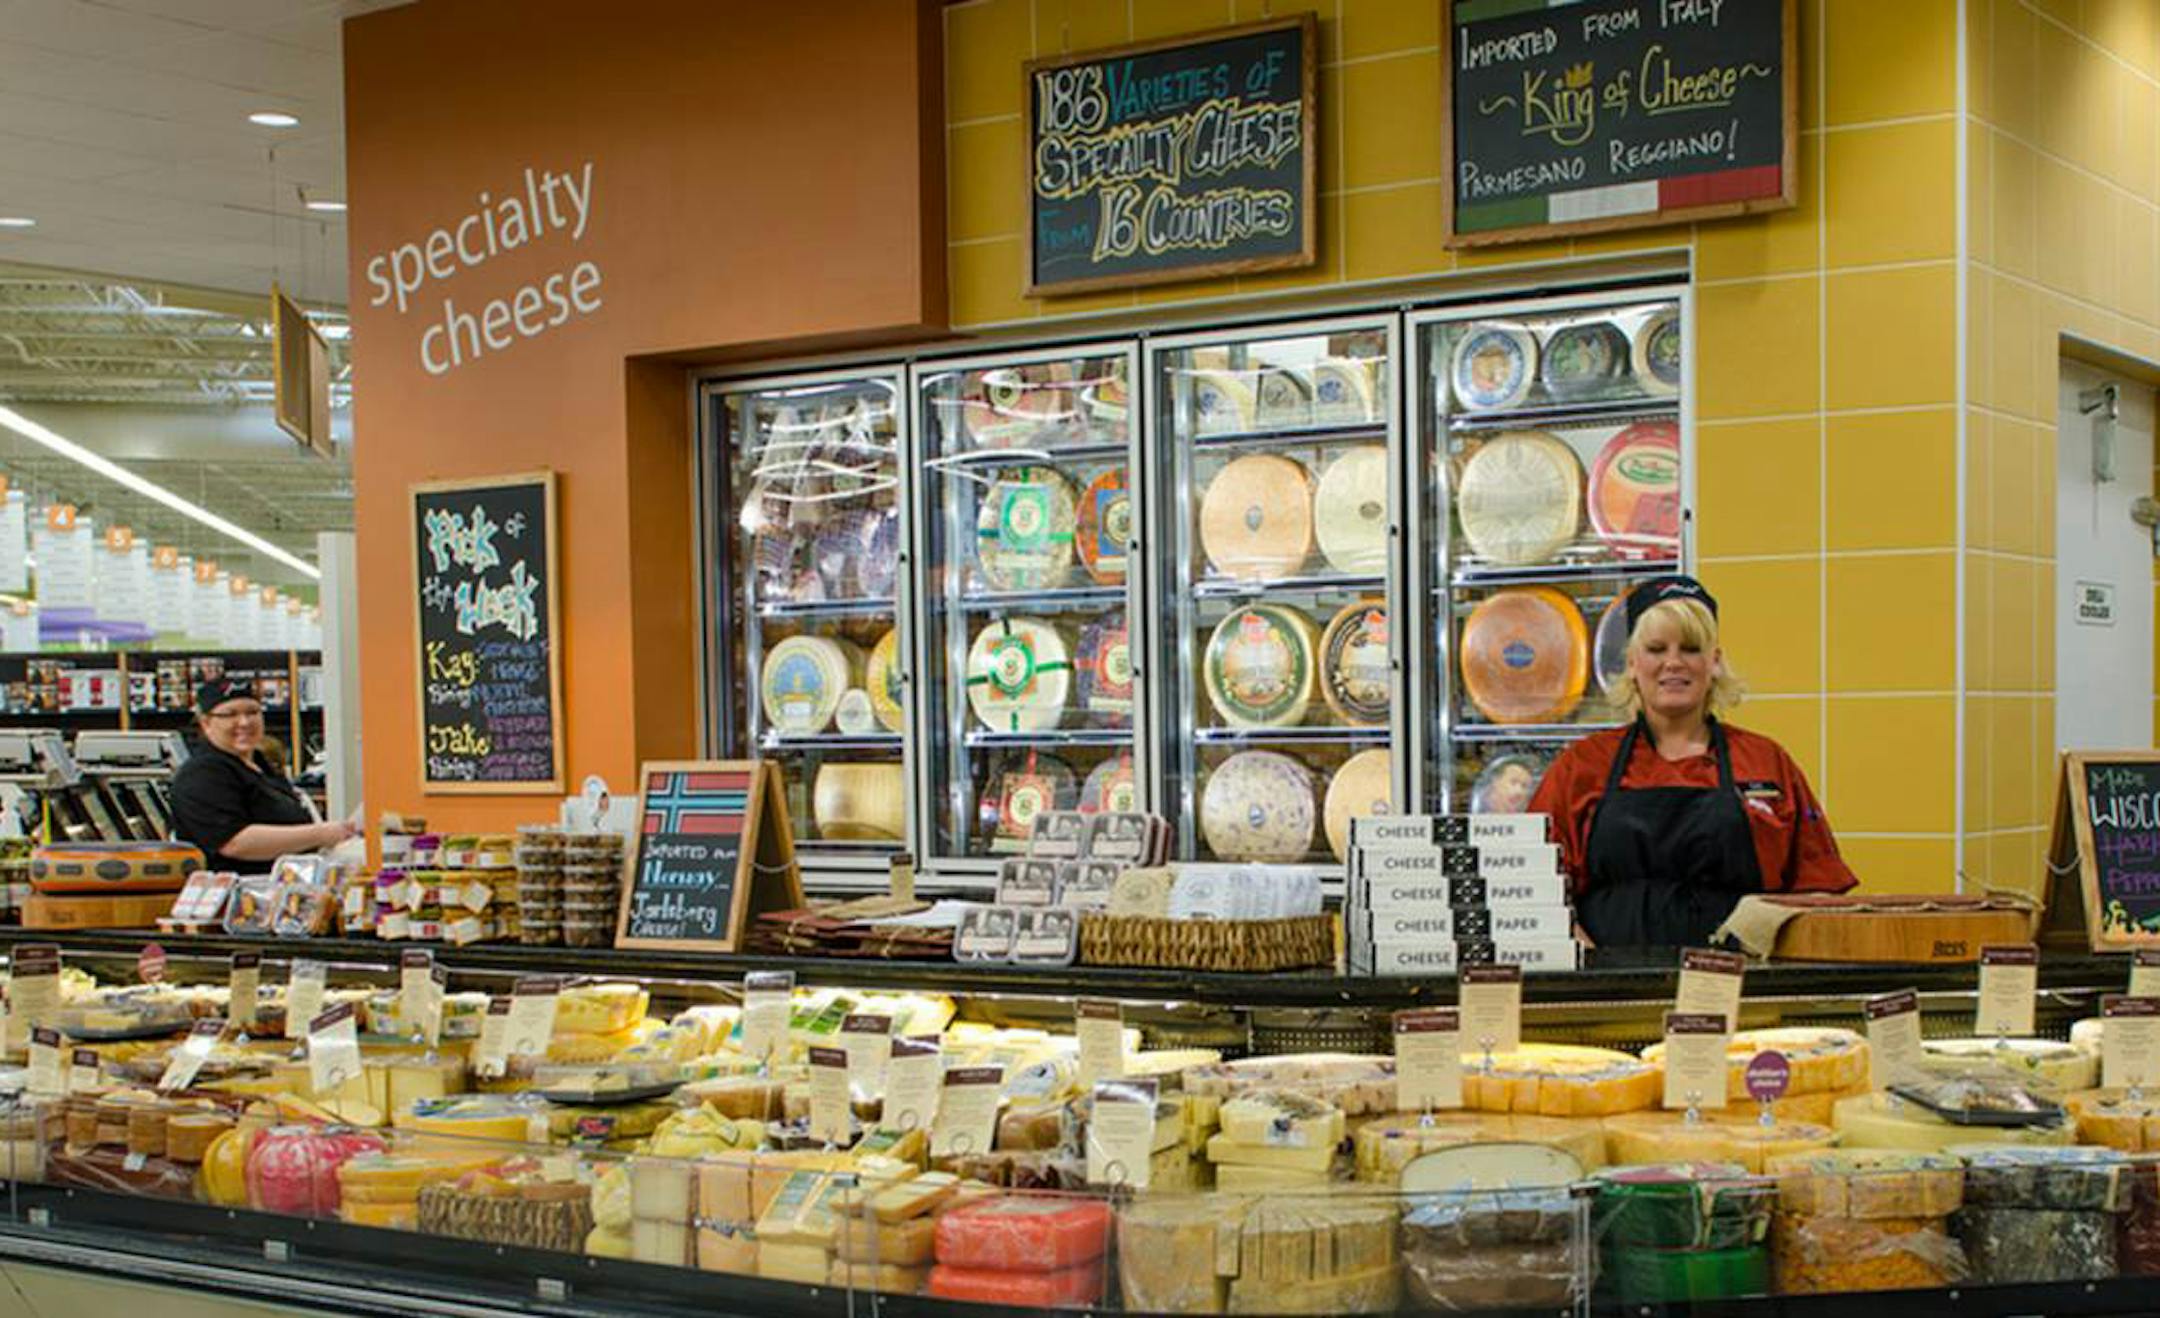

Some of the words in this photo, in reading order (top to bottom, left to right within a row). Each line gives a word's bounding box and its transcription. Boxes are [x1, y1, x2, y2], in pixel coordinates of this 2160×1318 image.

[1520, 69, 1595, 146] King
[1602, 70, 1633, 119] of
[1640, 45, 1737, 110] Cheese
[367, 162, 593, 313] specialty
[421, 261, 601, 374] cheese
[1376, 825, 1427, 839] CHEESE
[1474, 824, 1516, 837] PAPER
[1384, 857, 1436, 870] CHEESE
[1483, 856, 1526, 868] PAPER
[1391, 888, 1443, 901] CHEESE
[1491, 887, 1534, 899] PAPER
[1394, 919, 1447, 933] CHEESE
[1496, 918, 1539, 931] PAPER
[1397, 951, 1449, 965] CHEESE
[1500, 950, 1544, 963] PAPER
